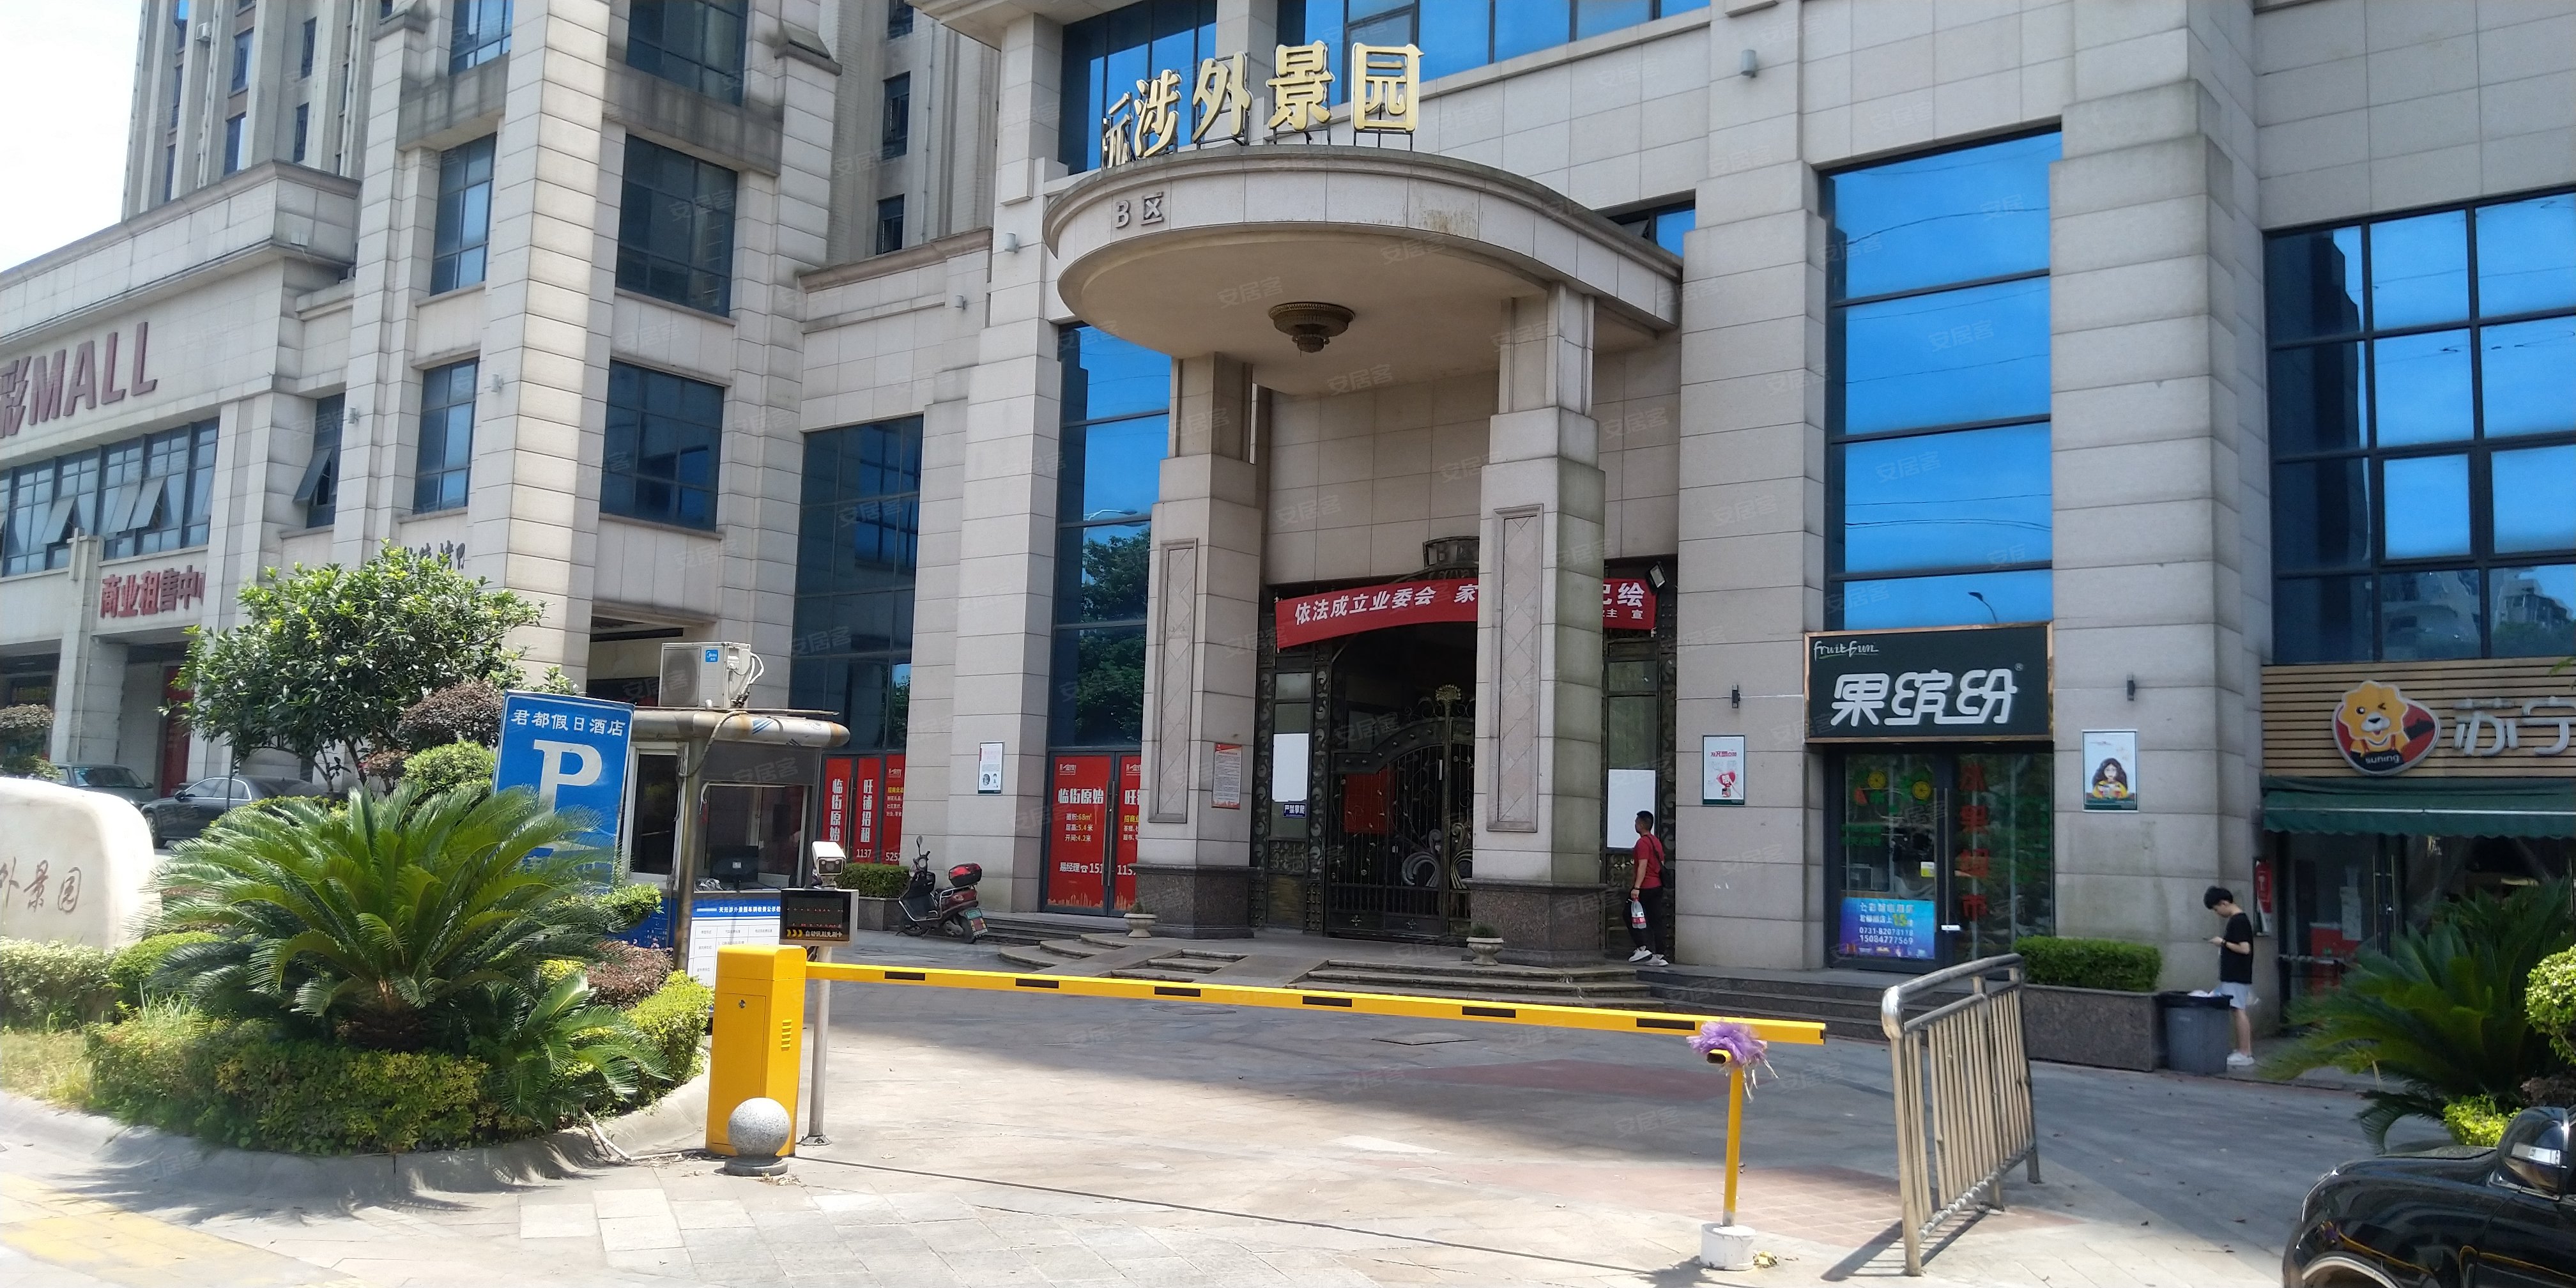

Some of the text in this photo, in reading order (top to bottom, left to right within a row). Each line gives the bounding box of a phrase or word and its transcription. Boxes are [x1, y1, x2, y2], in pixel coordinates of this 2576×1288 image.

[1102, 40, 1423, 170] 元涉外景园
[1295, 583, 1478, 625] 依法成立业委会 家
[1830, 668, 2019, 727] 果缤纷
[511, 709, 626, 737] 君都假日酒店
[2453, 696, 2576, 757] 苏宁
[2365, 755, 2400, 764] suning
[529, 739, 602, 851] P
[829, 778, 844, 842] 临街原始
[860, 779, 874, 843] 旺铺招租
[1057, 788, 1104, 804] 临街原始
[1124, 789, 1140, 805] 旺
[856, 848, 872, 859] 1137
[885, 852, 900, 862] 525
